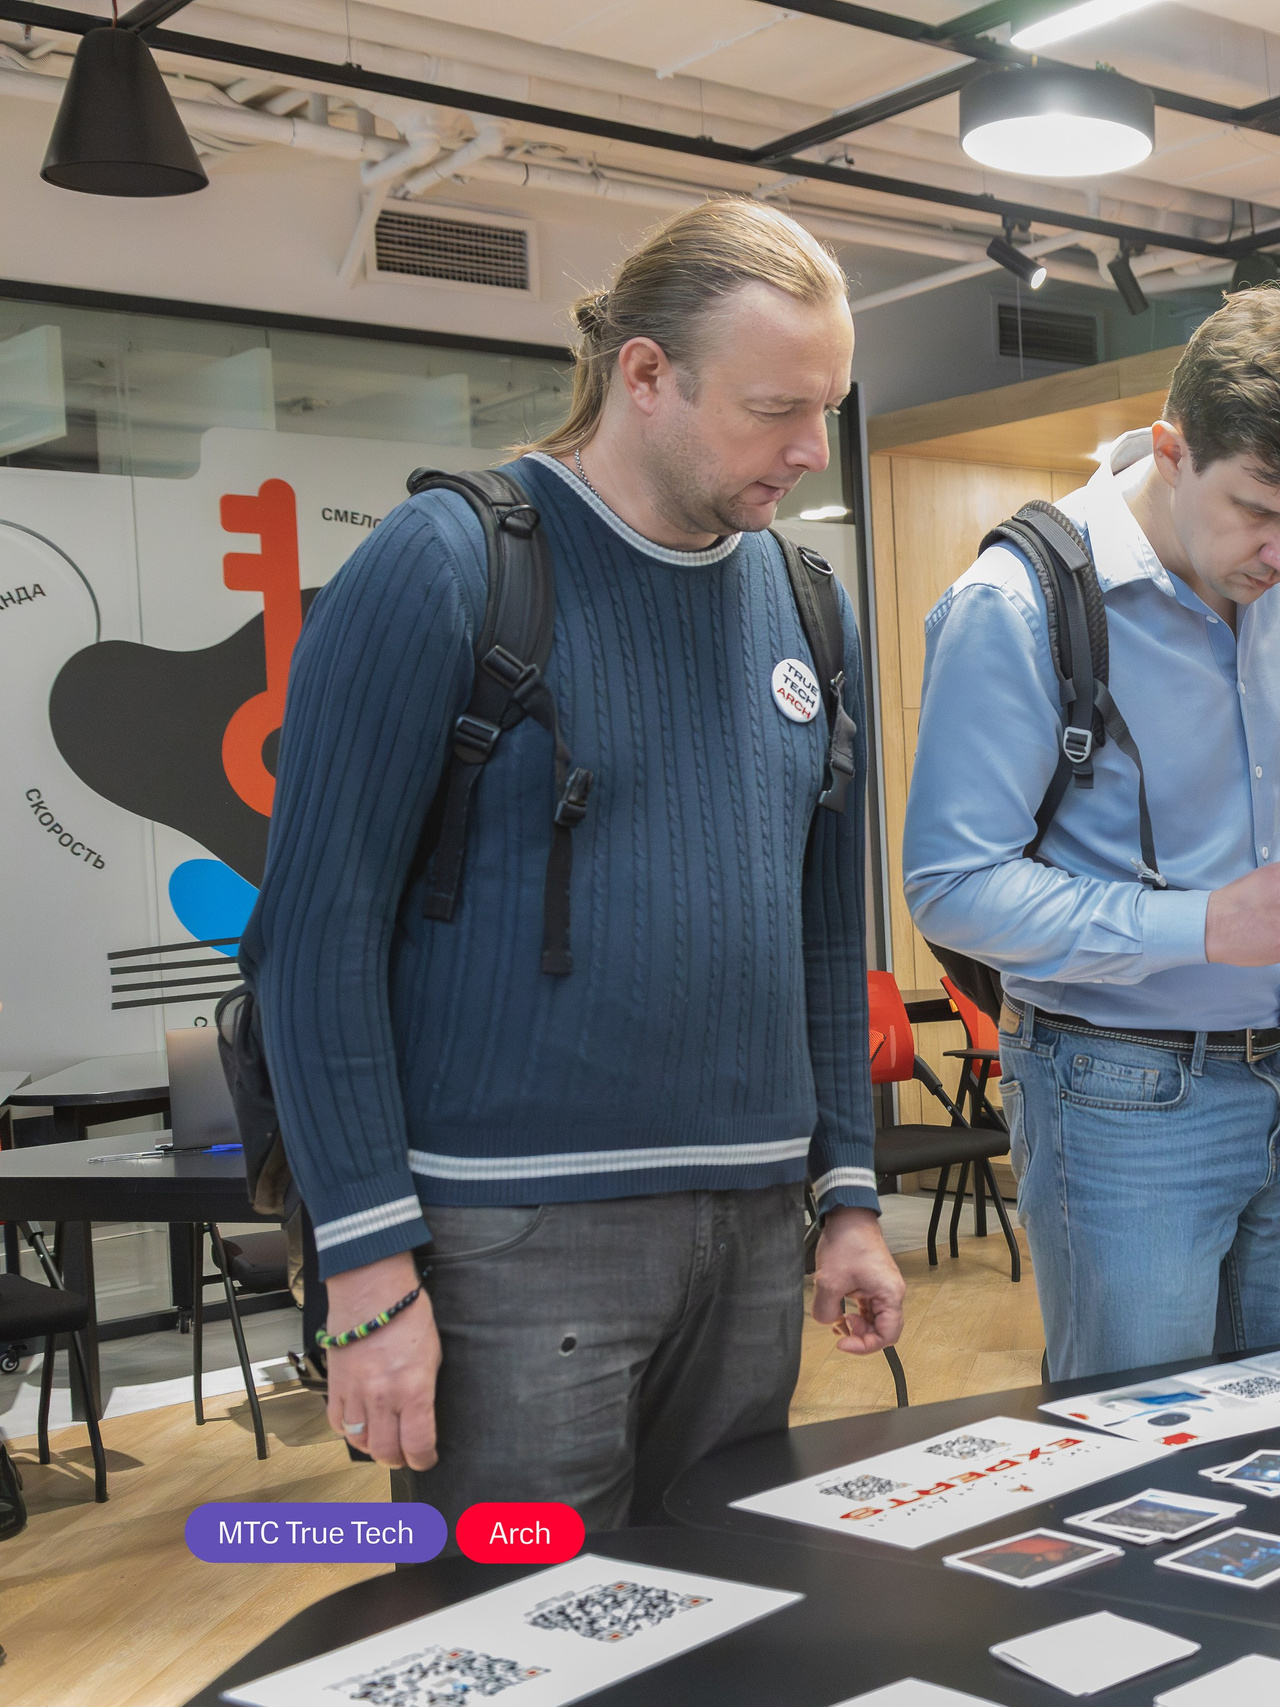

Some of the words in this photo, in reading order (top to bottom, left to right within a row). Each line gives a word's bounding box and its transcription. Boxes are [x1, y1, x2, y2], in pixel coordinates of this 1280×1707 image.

[0, 583, 46, 610] НДА
[783, 673, 815, 708] TECH
[786, 662, 819, 697] TRUE
[777, 687, 811, 719] ARCH
[25, 788, 105, 870] СКОРОСТЬ
